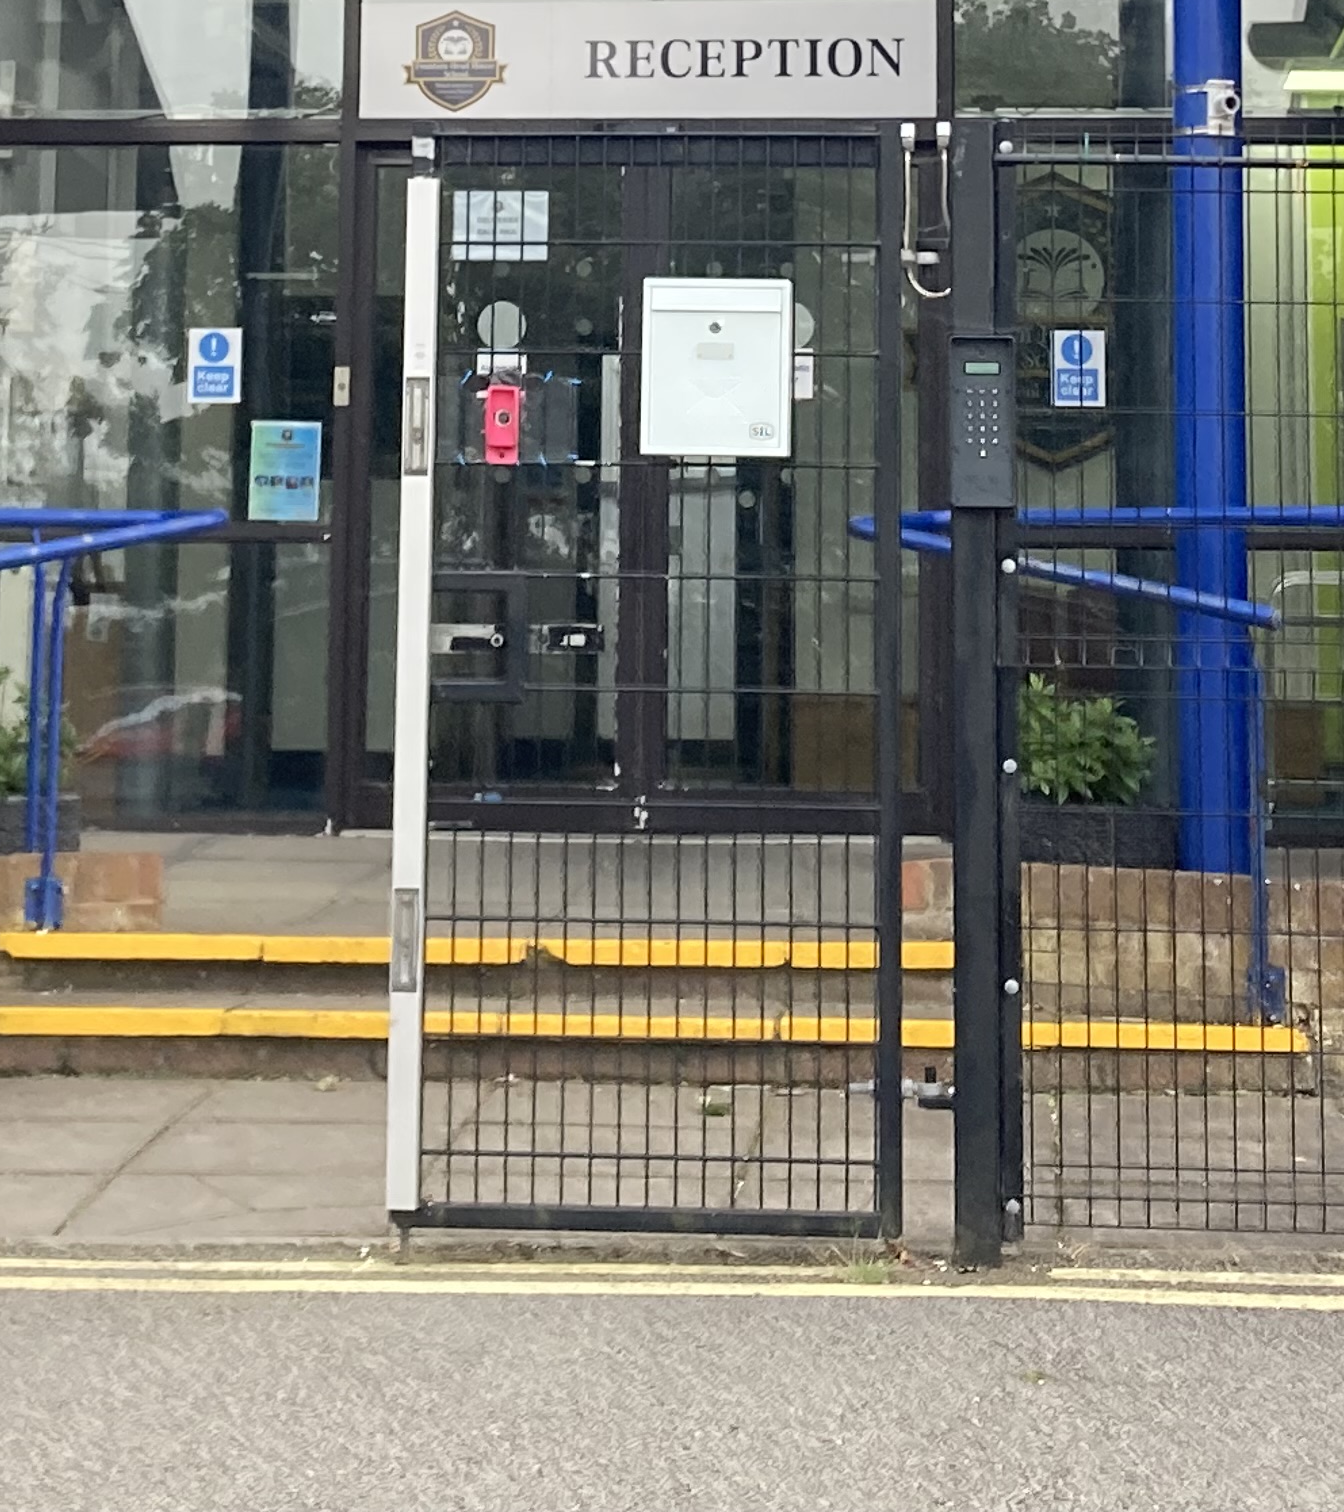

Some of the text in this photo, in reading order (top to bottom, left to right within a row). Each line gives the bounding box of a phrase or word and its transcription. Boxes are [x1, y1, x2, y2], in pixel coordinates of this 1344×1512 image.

[584, 37, 905, 79] RECEPTION
[197, 369, 229, 384] Keep
[1060, 373, 1094, 385] Keep
[197, 381, 229, 393] clear
[1060, 385, 1094, 396] clear
